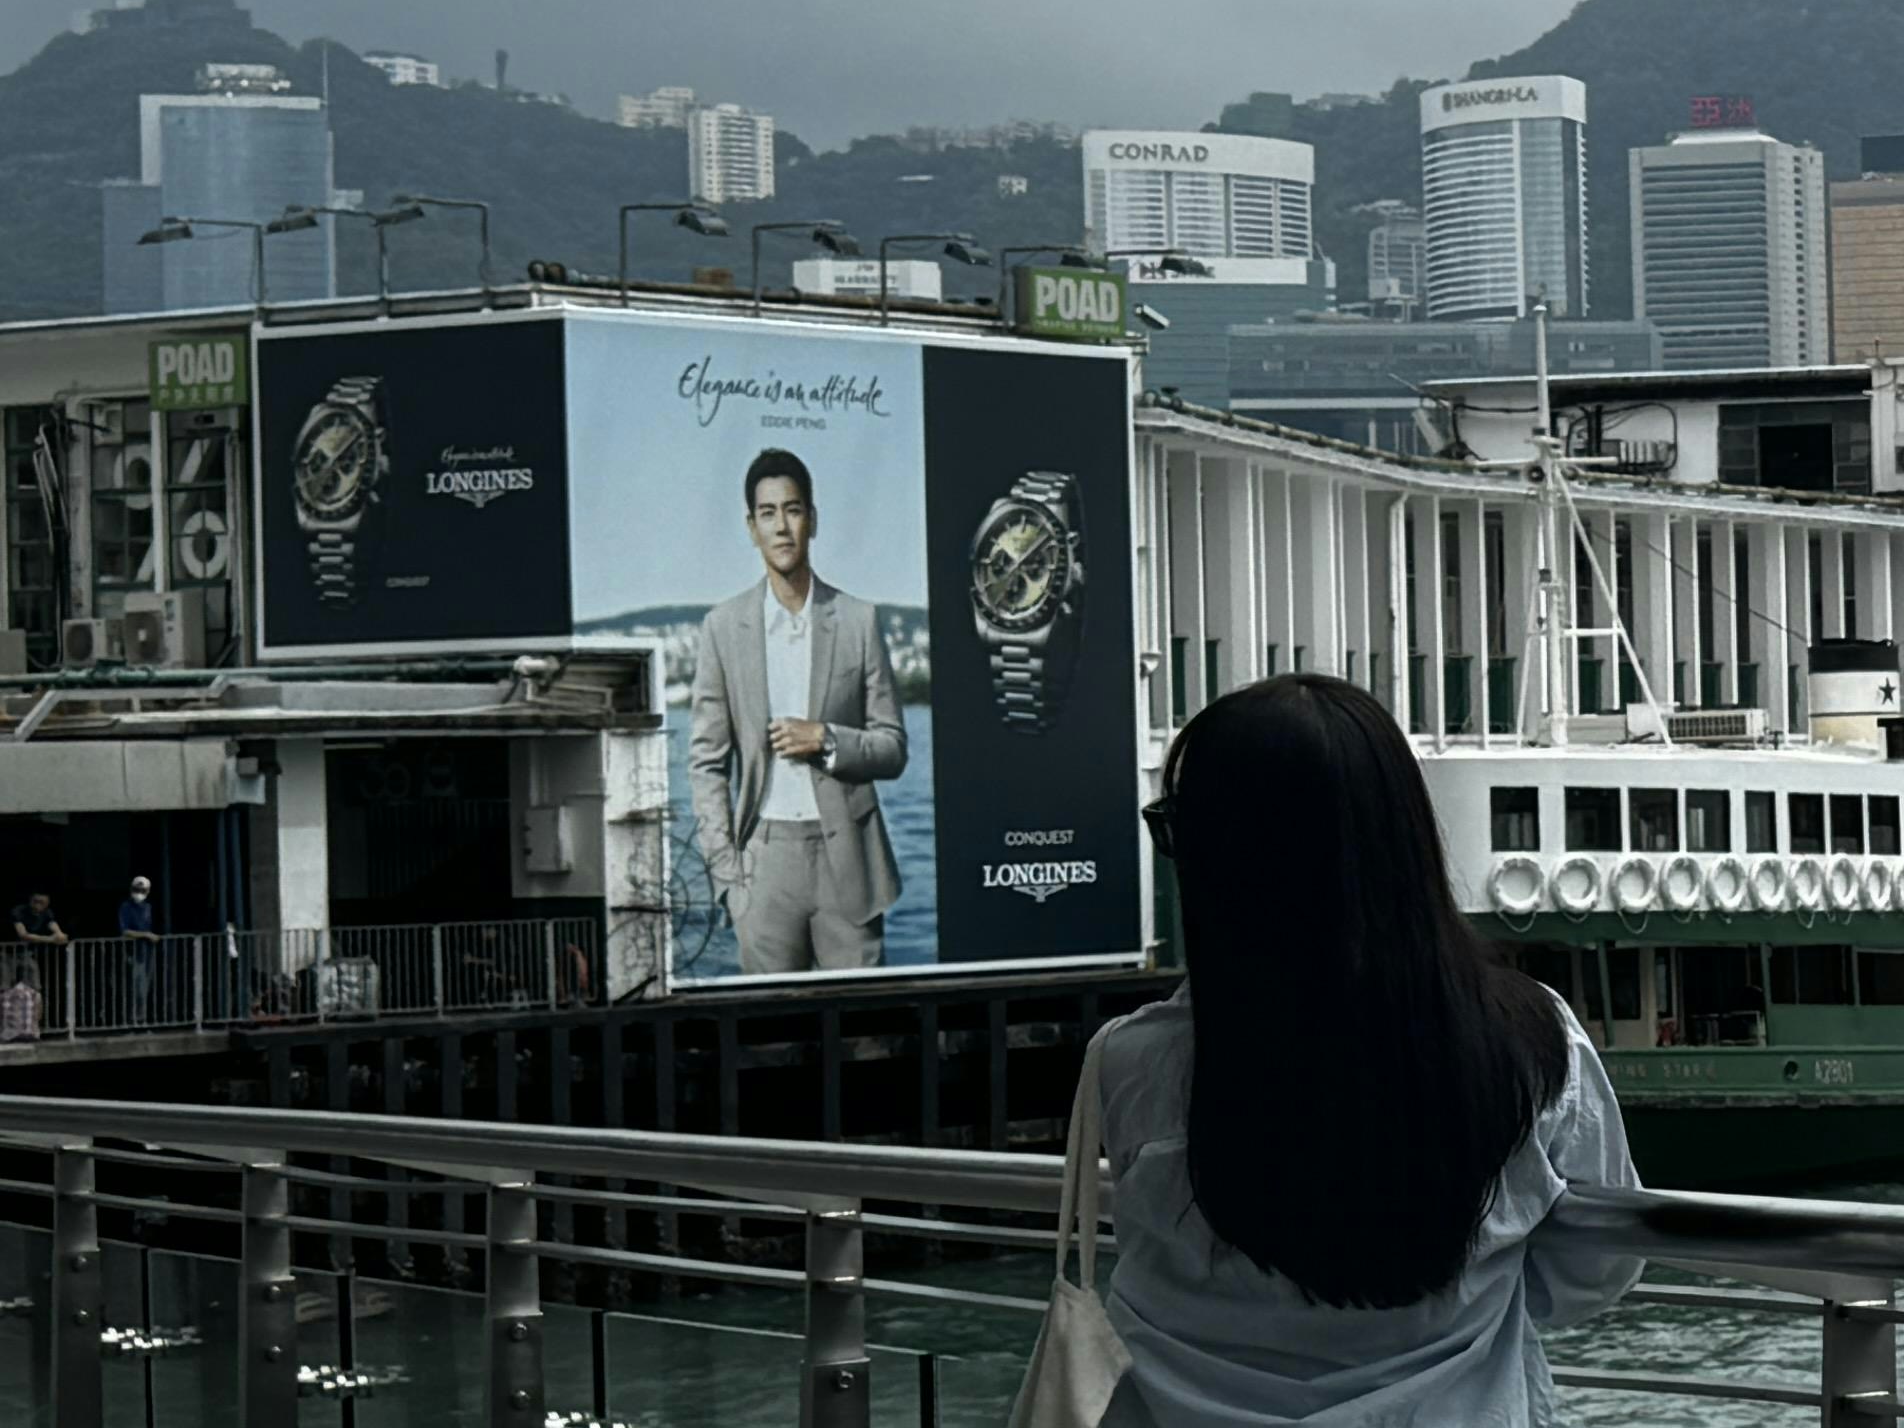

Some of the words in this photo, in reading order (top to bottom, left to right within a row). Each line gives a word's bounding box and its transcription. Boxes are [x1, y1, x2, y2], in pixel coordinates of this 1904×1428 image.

[1108, 142, 1209, 163] CONRAD
[1034, 274, 1120, 322] POAD
[158, 342, 234, 385] POAD
[678, 355, 761, 427] Elegance
[764, 370, 782, 403] is
[784, 382, 809, 411] an
[809, 374, 891, 417] attitude
[426, 468, 533, 494] LONGINES
[1005, 829, 1075, 846] CONQUEST
[982, 860, 1097, 887] LONGINES
